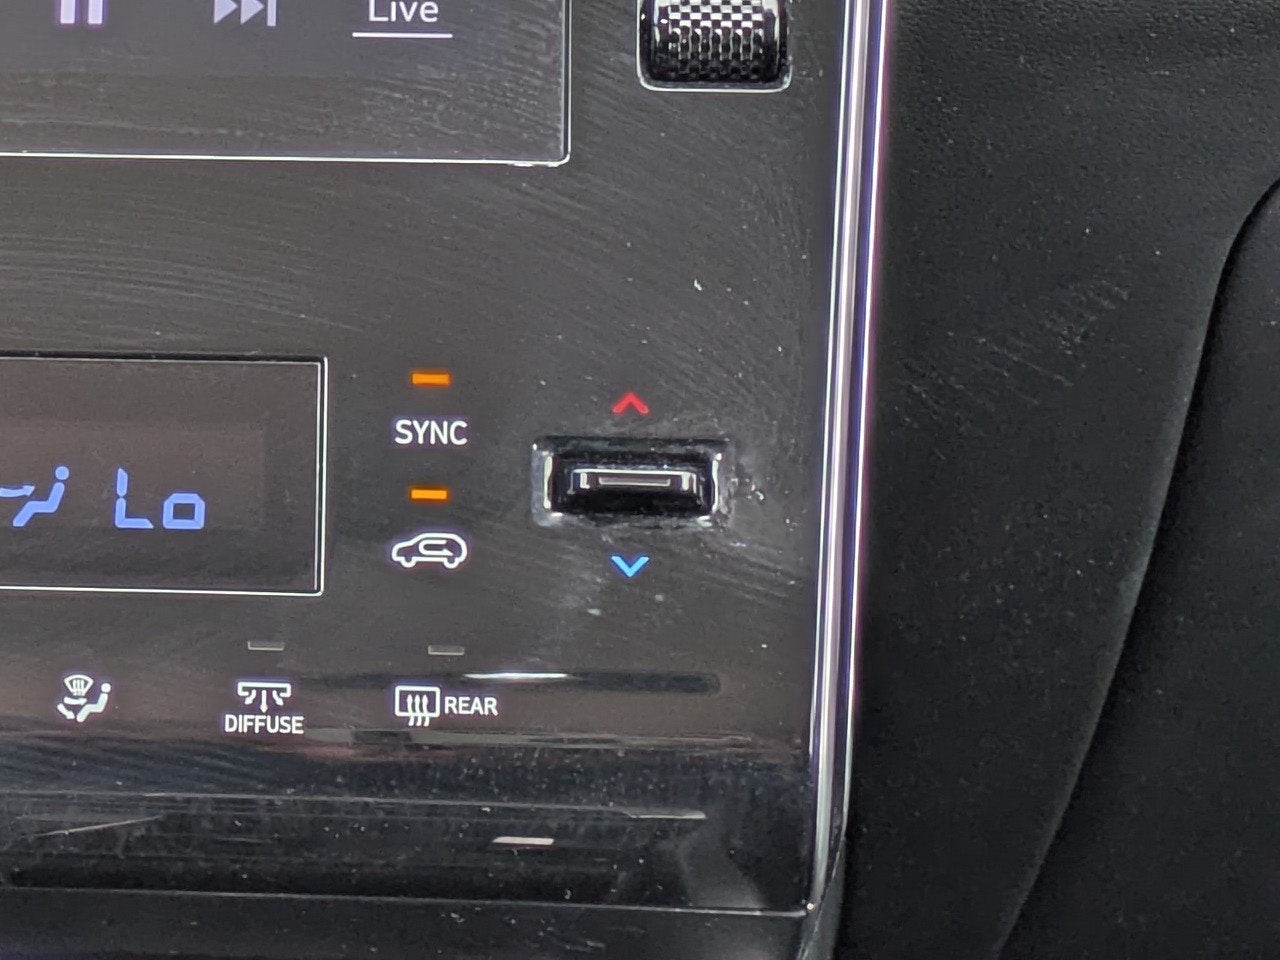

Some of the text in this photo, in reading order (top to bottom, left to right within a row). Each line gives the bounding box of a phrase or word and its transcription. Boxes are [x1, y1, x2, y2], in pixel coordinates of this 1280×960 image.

[394, 419, 468, 446] SYNC
[114, 467, 206, 530] Lo
[444, 696, 499, 716] REAR
[224, 713, 305, 735] DIFFUSE
